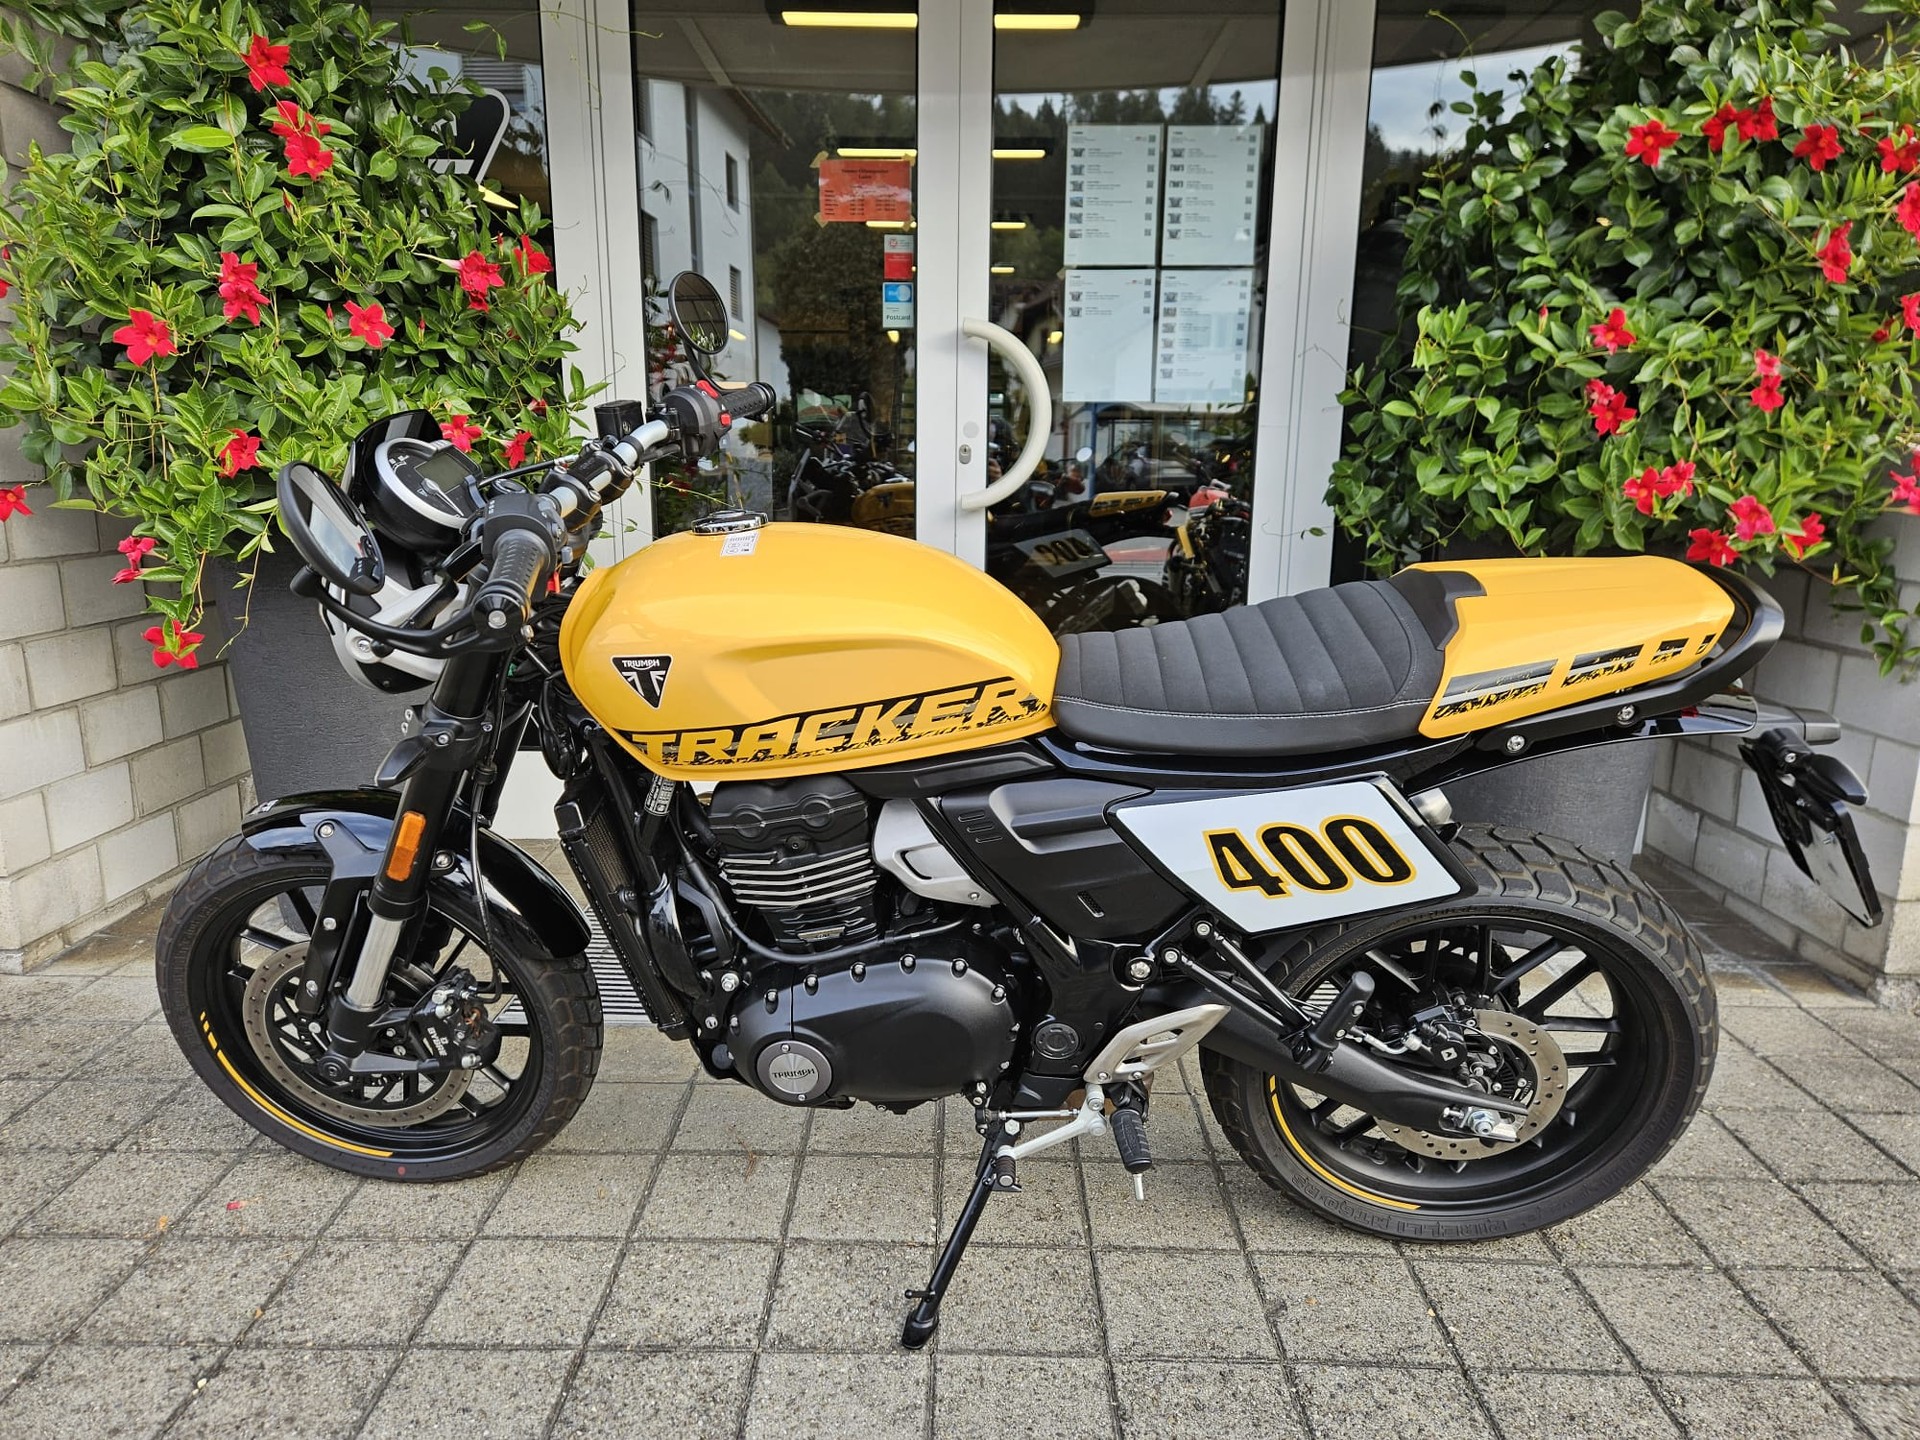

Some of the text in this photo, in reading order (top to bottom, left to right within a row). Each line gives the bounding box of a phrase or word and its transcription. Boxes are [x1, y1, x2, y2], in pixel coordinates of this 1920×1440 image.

[621, 659, 660, 671] TRIUMPH
[632, 679, 1037, 764] TRACKER
[1203, 814, 1417, 899] 400
[772, 1068, 816, 1080] TRIUMPH
